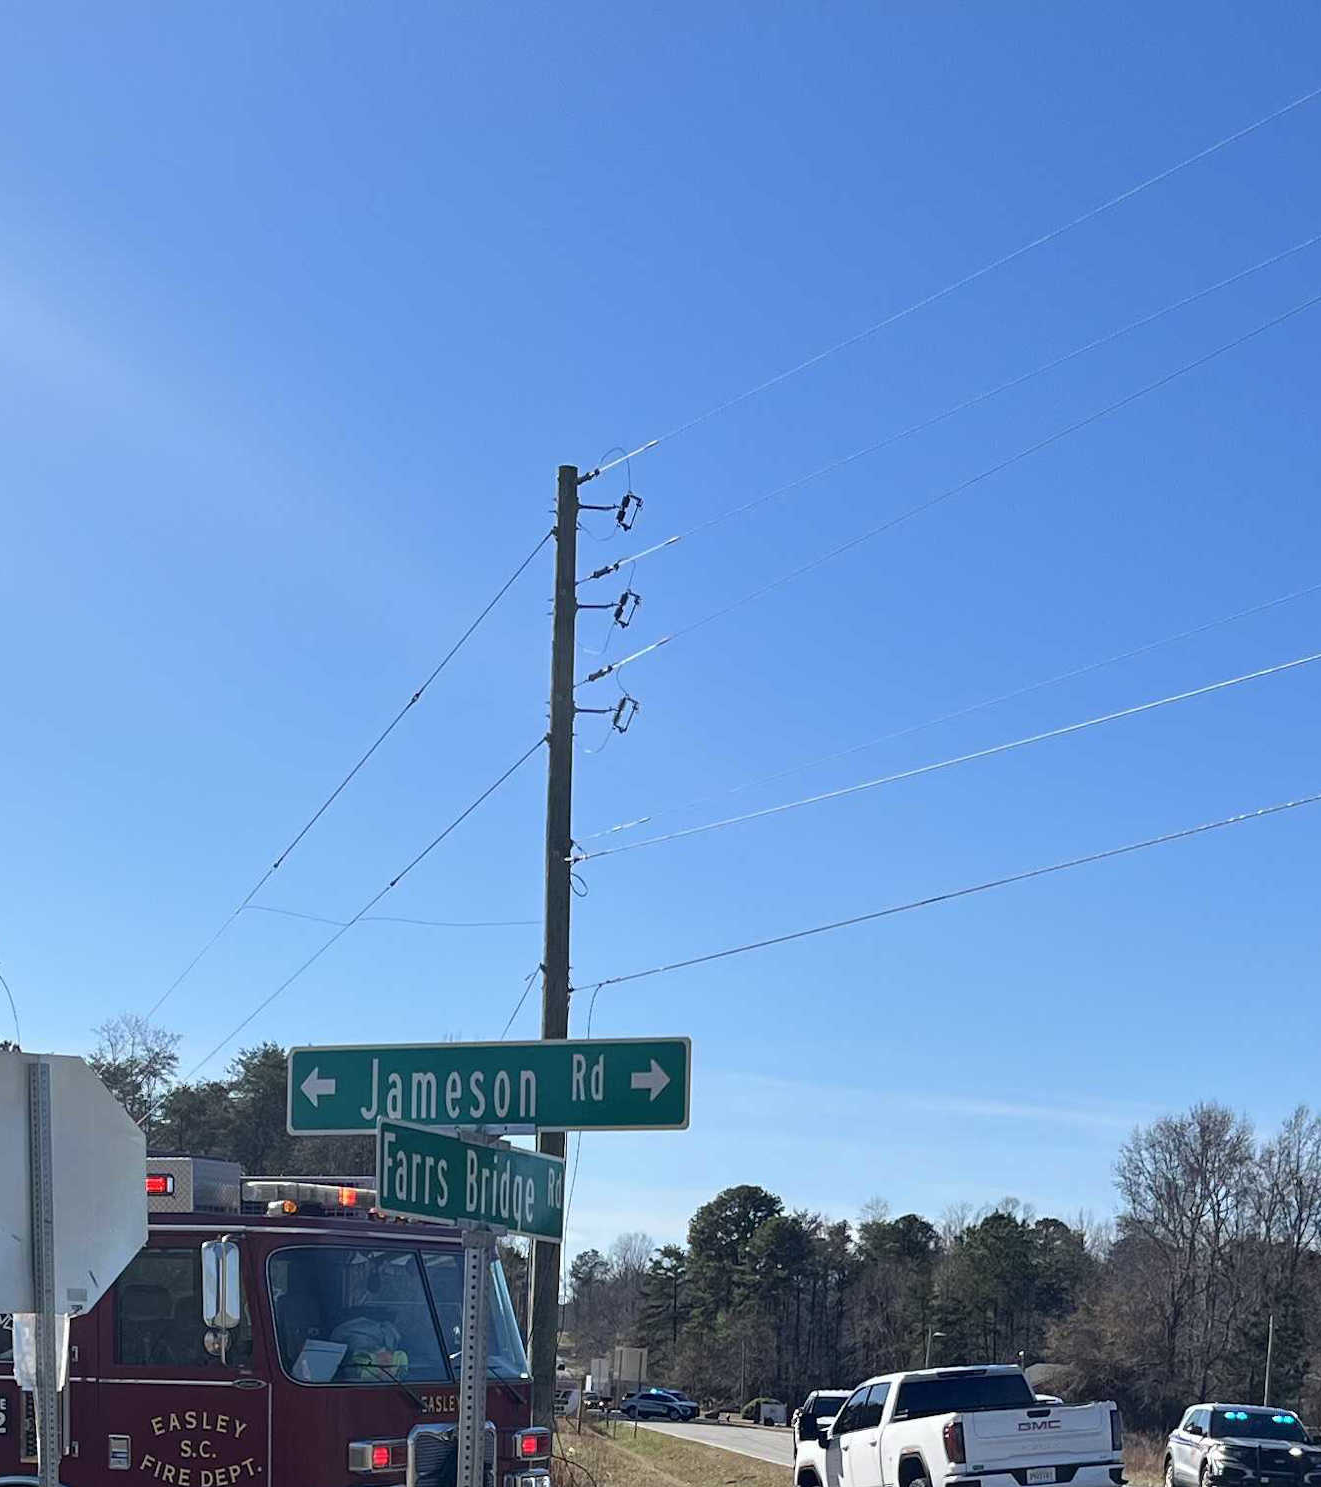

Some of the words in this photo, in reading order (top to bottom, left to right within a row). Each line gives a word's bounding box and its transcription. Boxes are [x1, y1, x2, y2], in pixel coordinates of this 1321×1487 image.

[360, 1058, 536, 1121] Jameson
[572, 1054, 605, 1102] Rd
[382, 1132, 449, 1208] Farrs
[466, 1149, 536, 1231] Bridge
[547, 1168, 562, 1210] Rd
[150, 1410, 248, 1438] EASLEY
[1018, 1420, 1061, 1432] GMC
[180, 1440, 217, 1459] S.C.
[139, 1454, 191, 1486] FIRE
[200, 1458, 262, 1487] DEPT.
